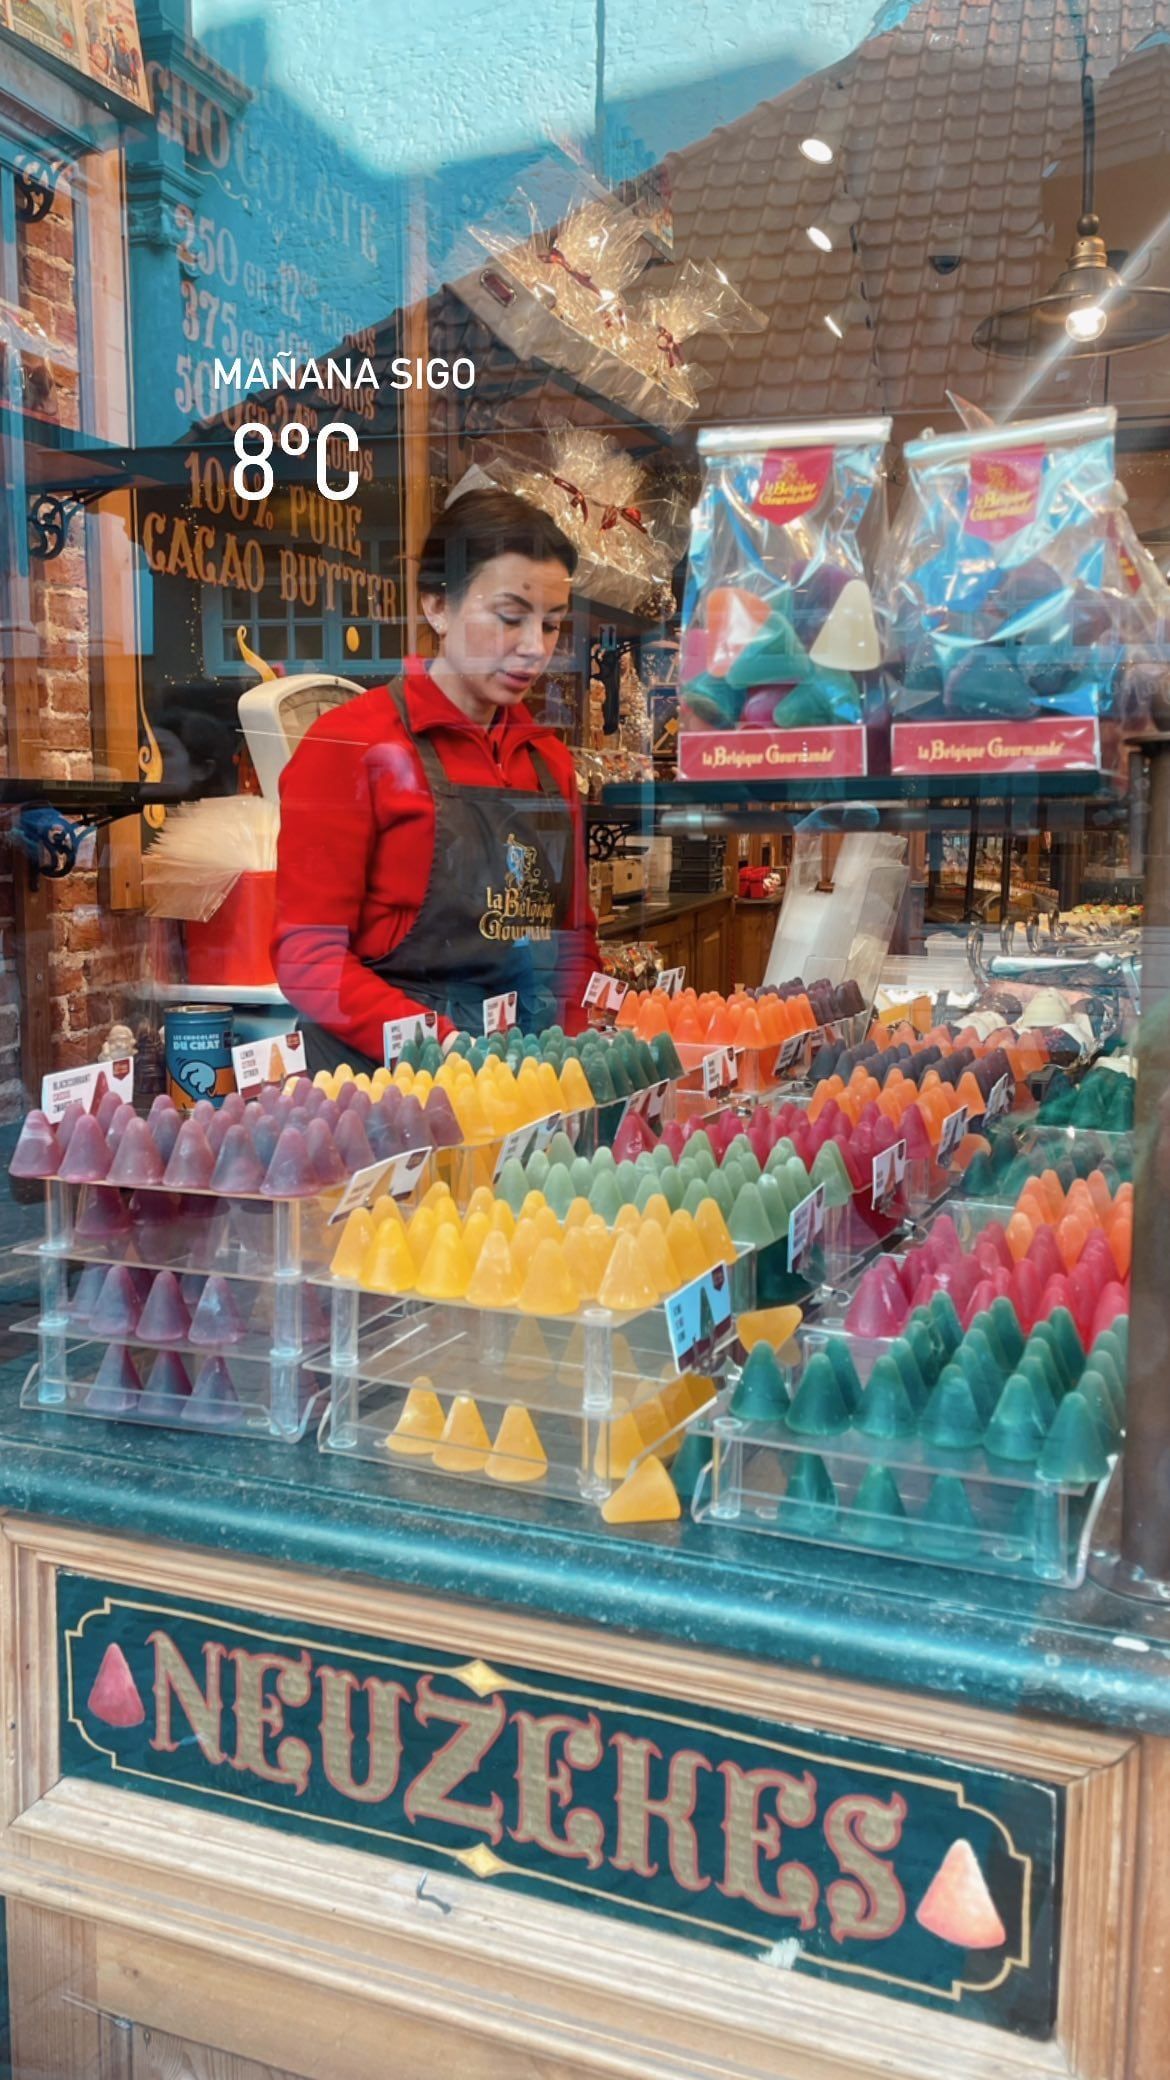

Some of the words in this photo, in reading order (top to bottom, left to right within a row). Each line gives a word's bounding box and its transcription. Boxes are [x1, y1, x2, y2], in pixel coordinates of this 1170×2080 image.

[175, 203, 238, 287] 250
[181, 280, 238, 357] 375
[184, 452, 274, 531] 100%
[288, 483, 363, 560] PURE
[142, 511, 265, 593] CACAO
[280, 549, 397, 625] BUTTER
[486, 886, 503, 909] la
[172, 1040, 188, 1051] DU
[189, 1039, 220, 1050] CHAT
[145, 1629, 907, 1944] NEUZEKES
